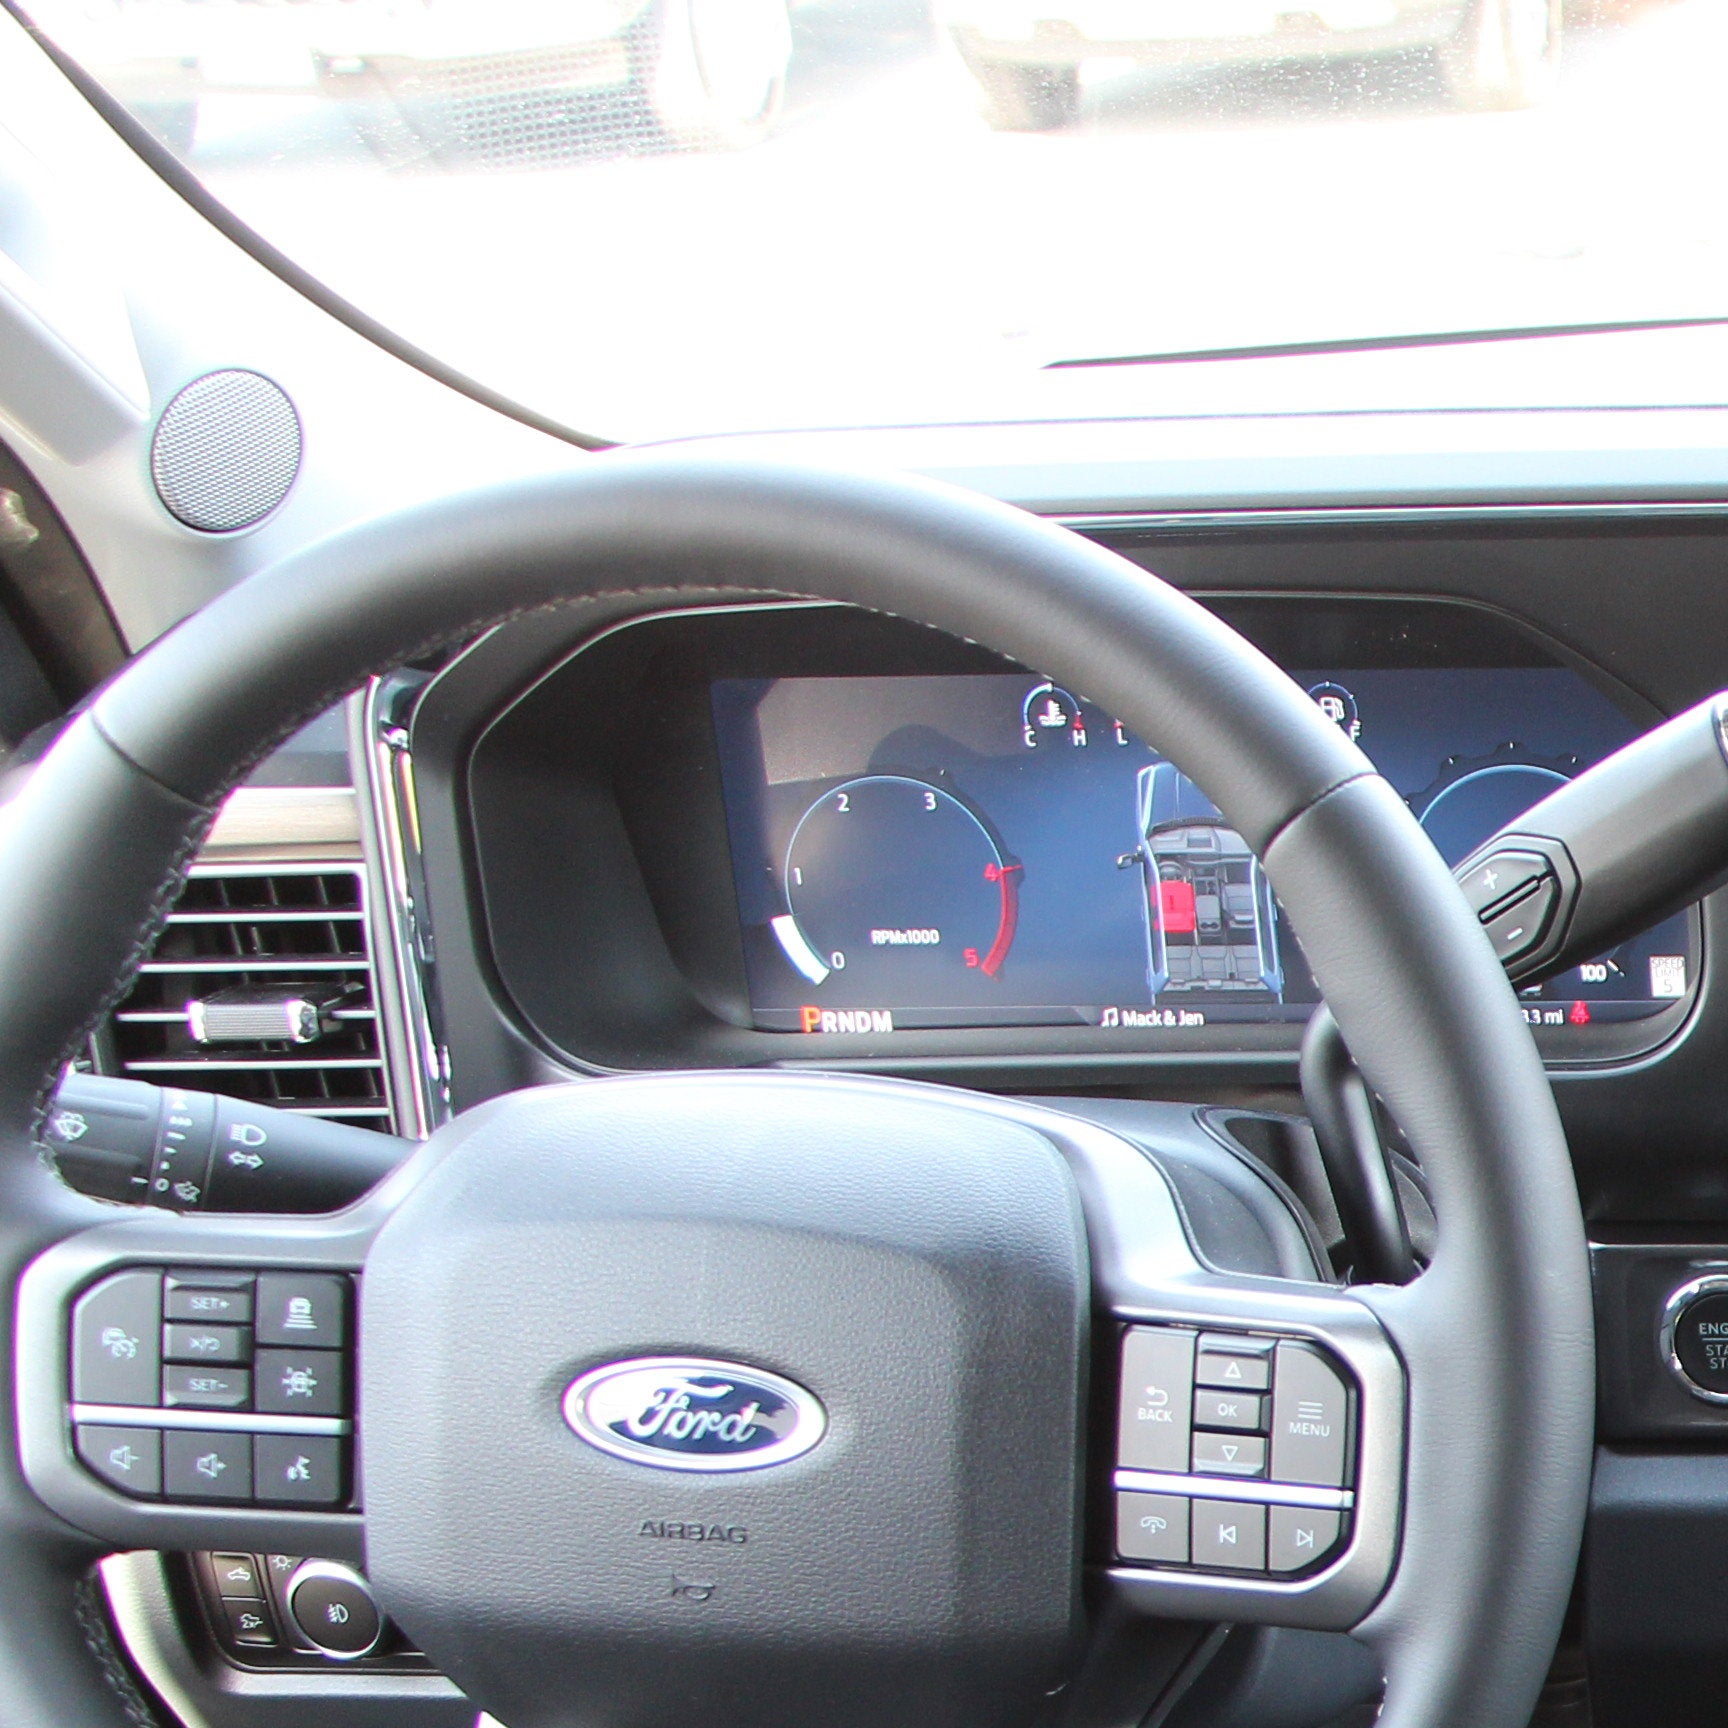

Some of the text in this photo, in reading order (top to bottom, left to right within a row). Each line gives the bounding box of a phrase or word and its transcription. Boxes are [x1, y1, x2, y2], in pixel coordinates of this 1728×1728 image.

[1073, 730, 1087, 746] H
[837, 794, 850, 812] 2
[924, 792, 937, 811] 3
[794, 867, 803, 885] 1
[831, 952, 846, 969] 0
[963, 947, 979, 967] 5
[1651, 957, 1684, 969] SPEED
[1580, 964, 1607, 982] 100
[1663, 979, 1673, 993] 5
[1122, 1009, 1205, 1027] Mack & Jen
[1544, 1008, 1564, 1025] mi
[627, 1376, 760, 1443] Ford
[1137, 1407, 1173, 1423] BACK
[1217, 1403, 1238, 1417] OK
[1288, 1423, 1331, 1438] MENU
[637, 1519, 749, 1544] AIRBAG
